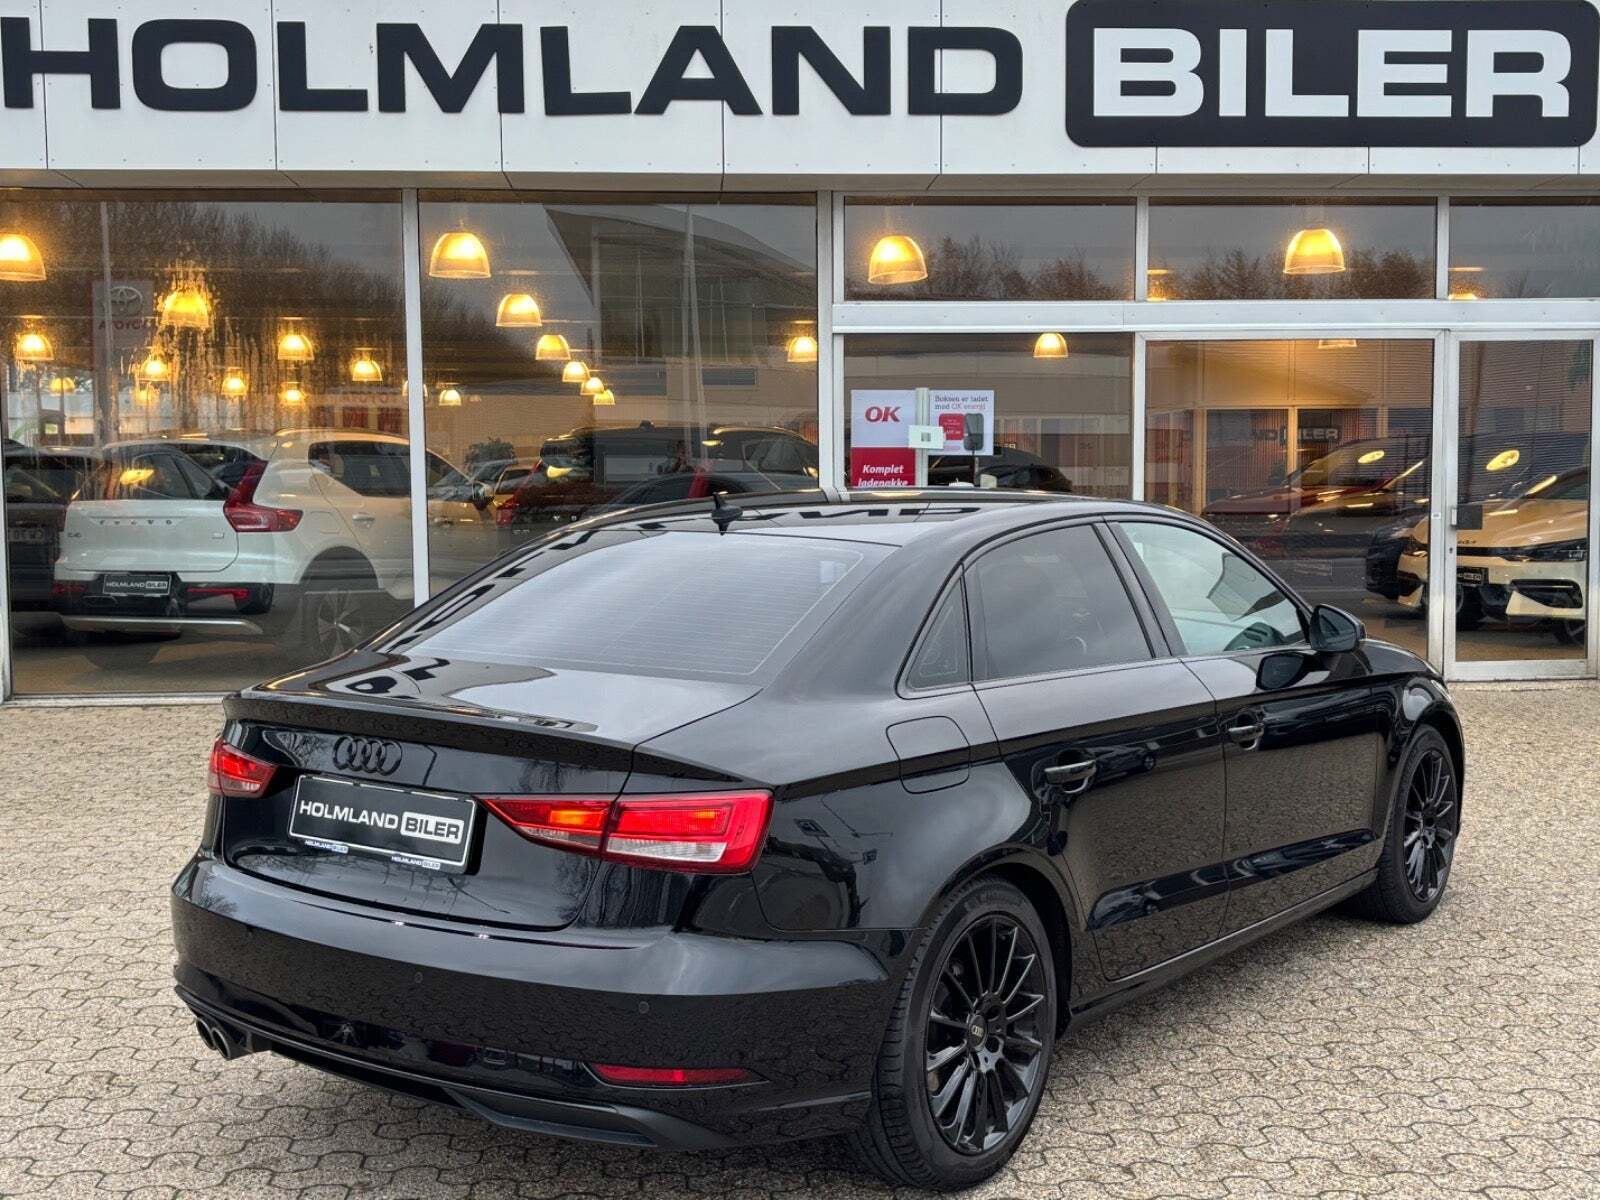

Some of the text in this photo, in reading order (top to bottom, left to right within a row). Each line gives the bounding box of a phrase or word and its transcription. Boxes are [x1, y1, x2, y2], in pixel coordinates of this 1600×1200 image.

[0, 16, 1572, 118] HOLMLAND BILER
[864, 406, 902, 423] OK
[862, 464, 905, 476] Komplet
[299, 800, 460, 840] HOLMLAND BILER
